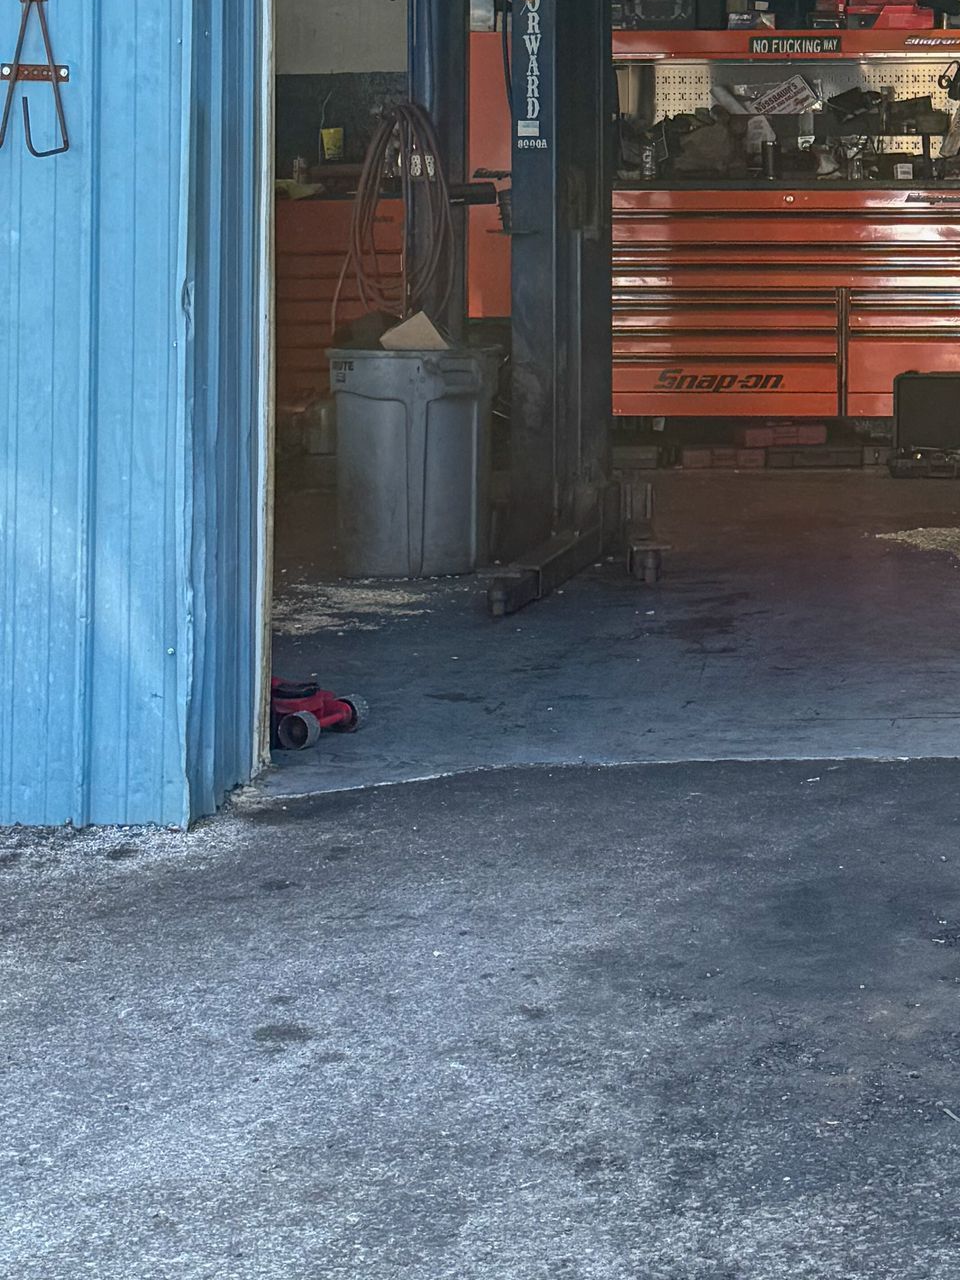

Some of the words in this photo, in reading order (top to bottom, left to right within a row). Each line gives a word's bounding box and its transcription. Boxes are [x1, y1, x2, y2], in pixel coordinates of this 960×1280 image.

[752, 39, 769, 54] NO
[772, 39, 821, 54] FUCKING
[823, 38, 839, 51] WAY
[653, 367, 784, 394] Snap-on
